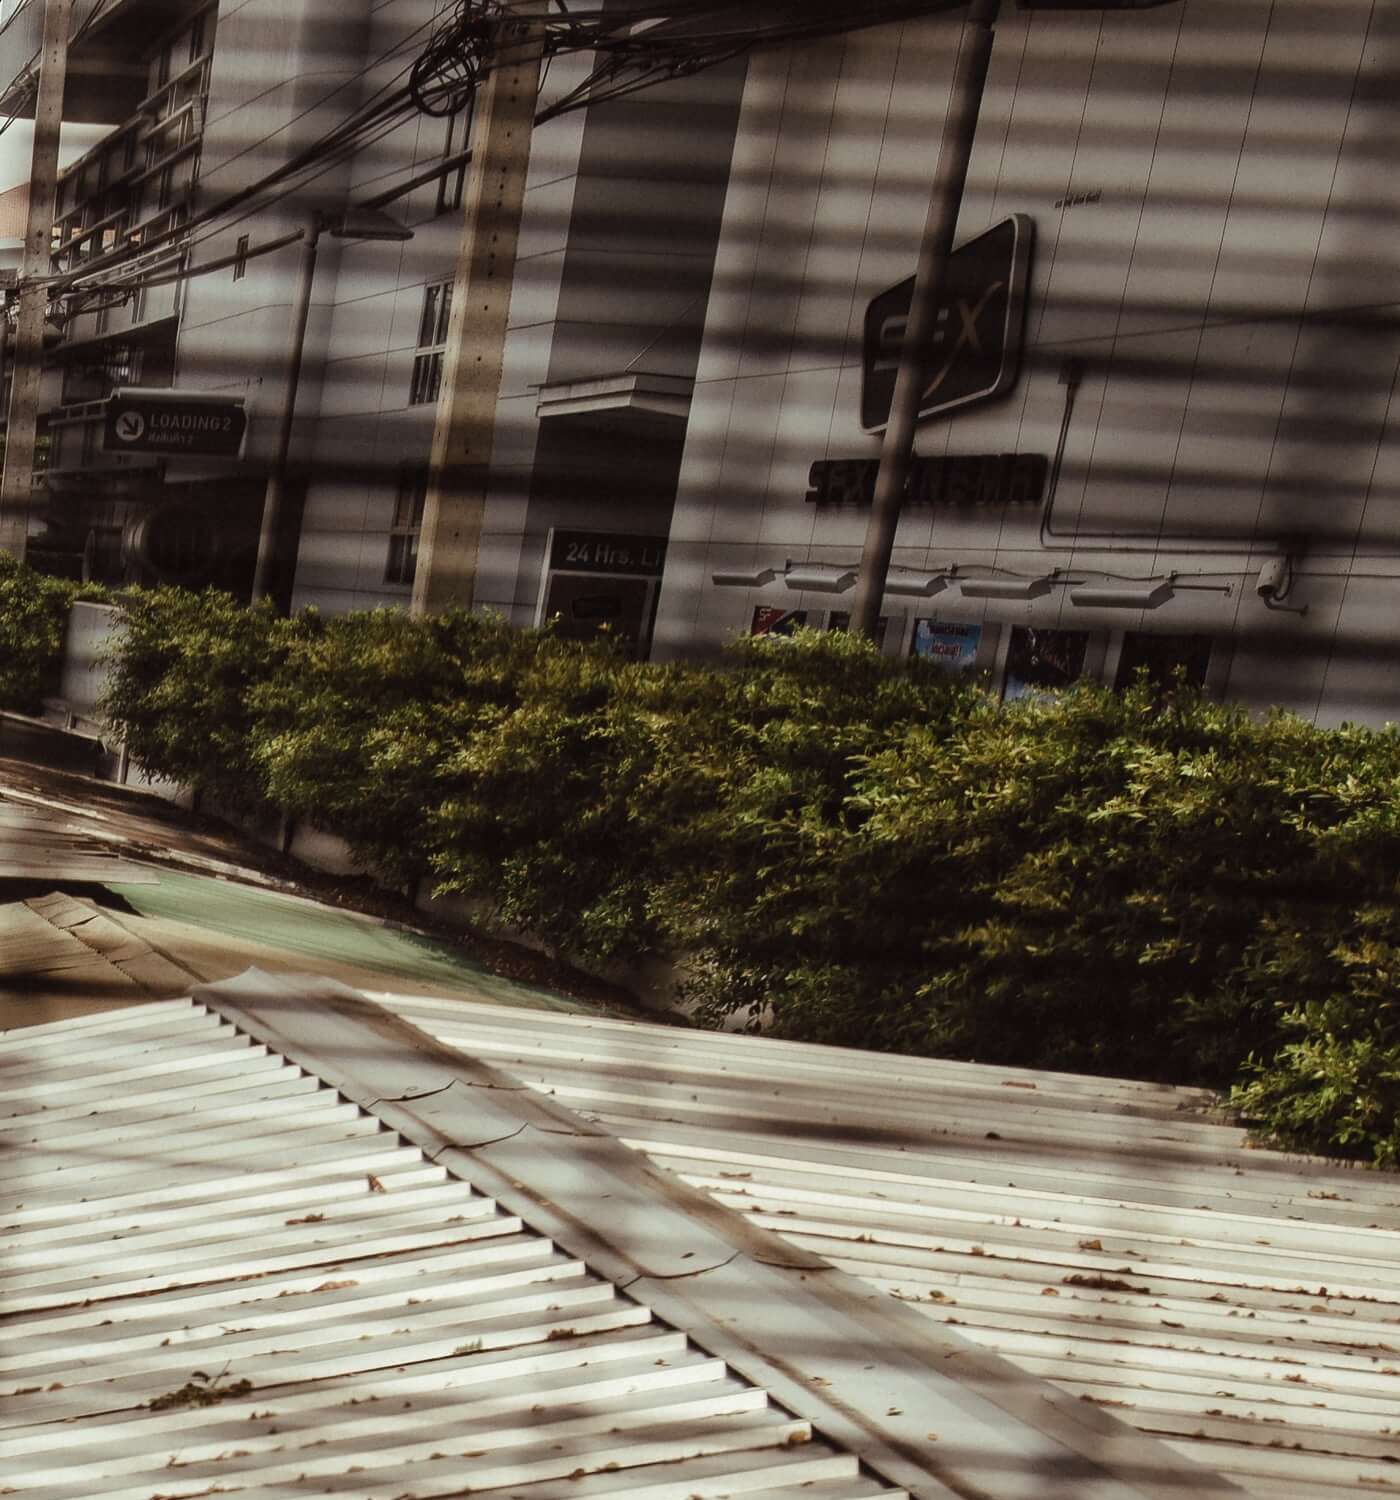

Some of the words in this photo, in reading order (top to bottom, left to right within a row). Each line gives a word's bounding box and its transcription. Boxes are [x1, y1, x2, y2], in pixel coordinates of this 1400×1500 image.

[150, 413, 221, 431] LOADING
[223, 416, 232, 431] 2
[565, 541, 589, 563] 24
[594, 543, 634, 567] Hrs.
